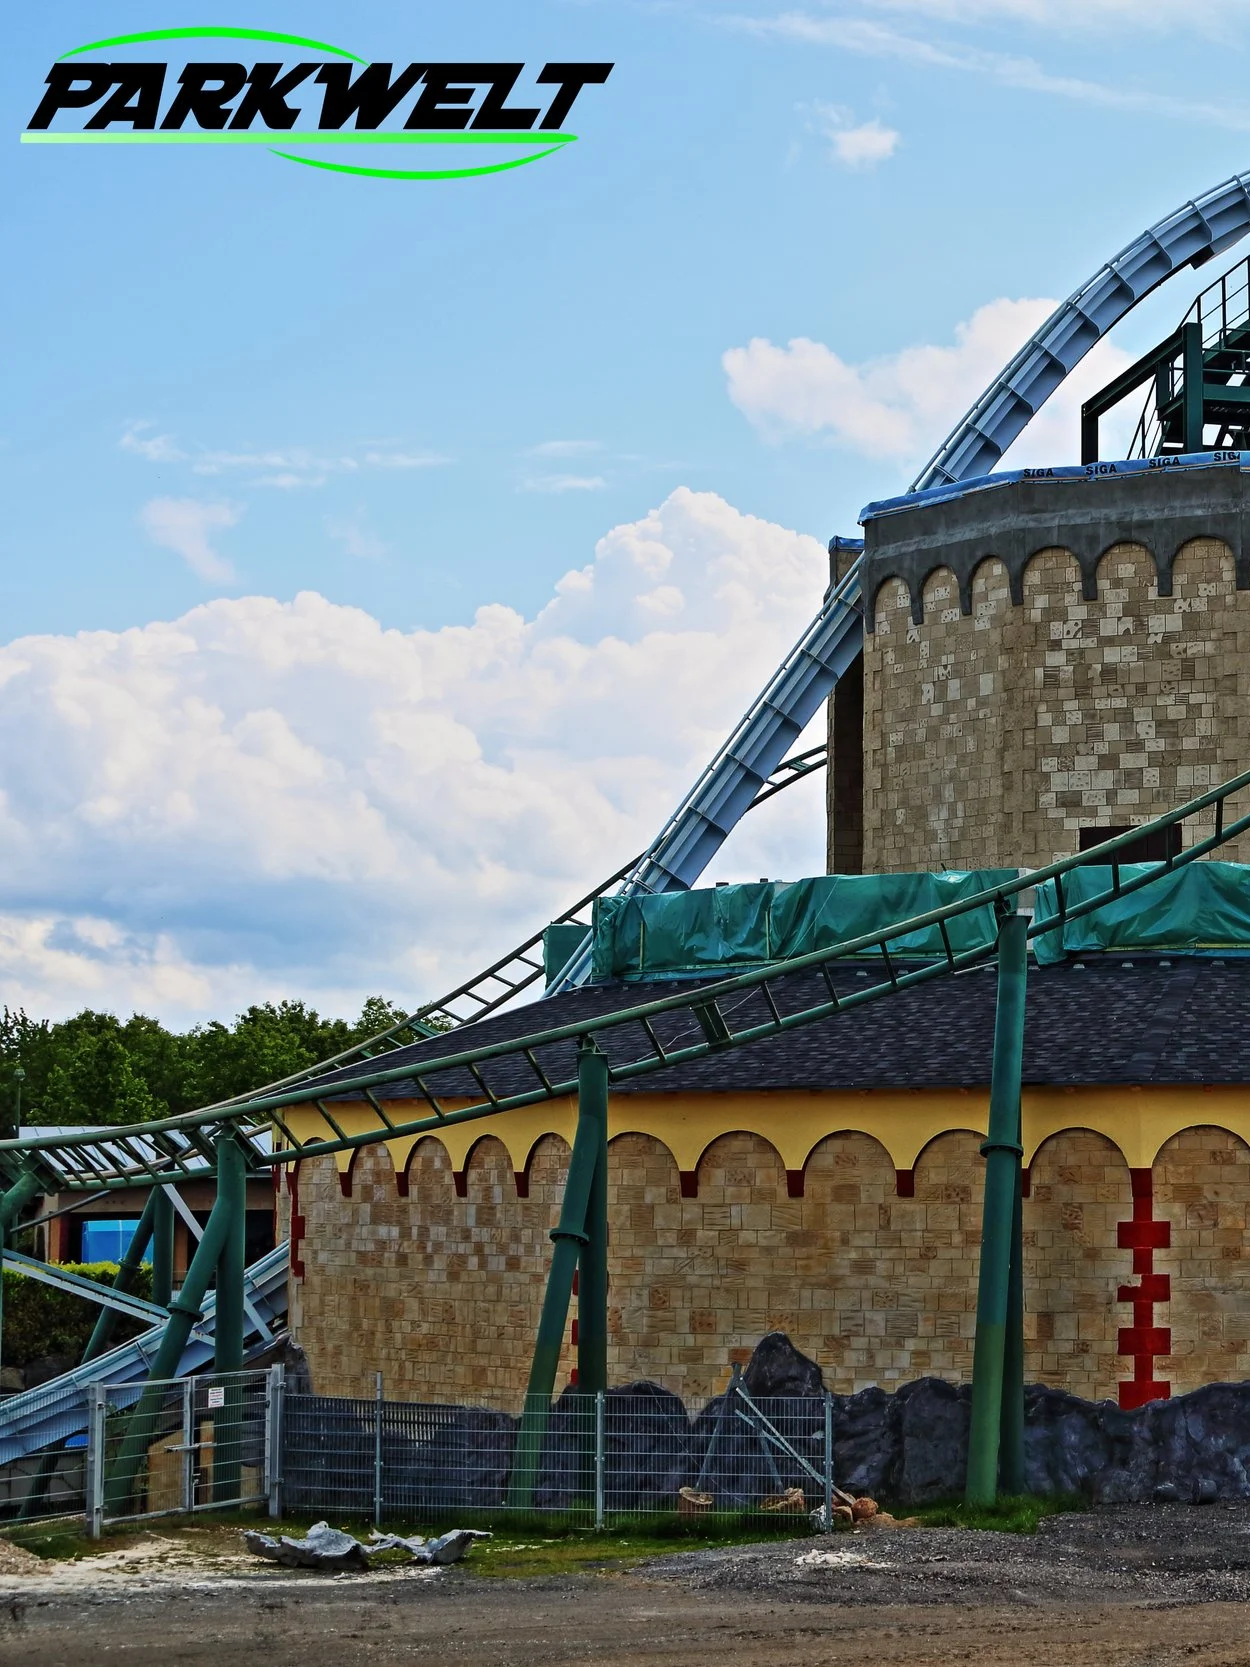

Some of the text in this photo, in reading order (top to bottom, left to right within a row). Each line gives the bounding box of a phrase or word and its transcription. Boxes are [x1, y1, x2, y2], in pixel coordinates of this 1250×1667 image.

[1023, 467, 1054, 477] SIGA
[1085, 463, 1117, 475] SIGA
[1148, 456, 1180, 468] SIGA
